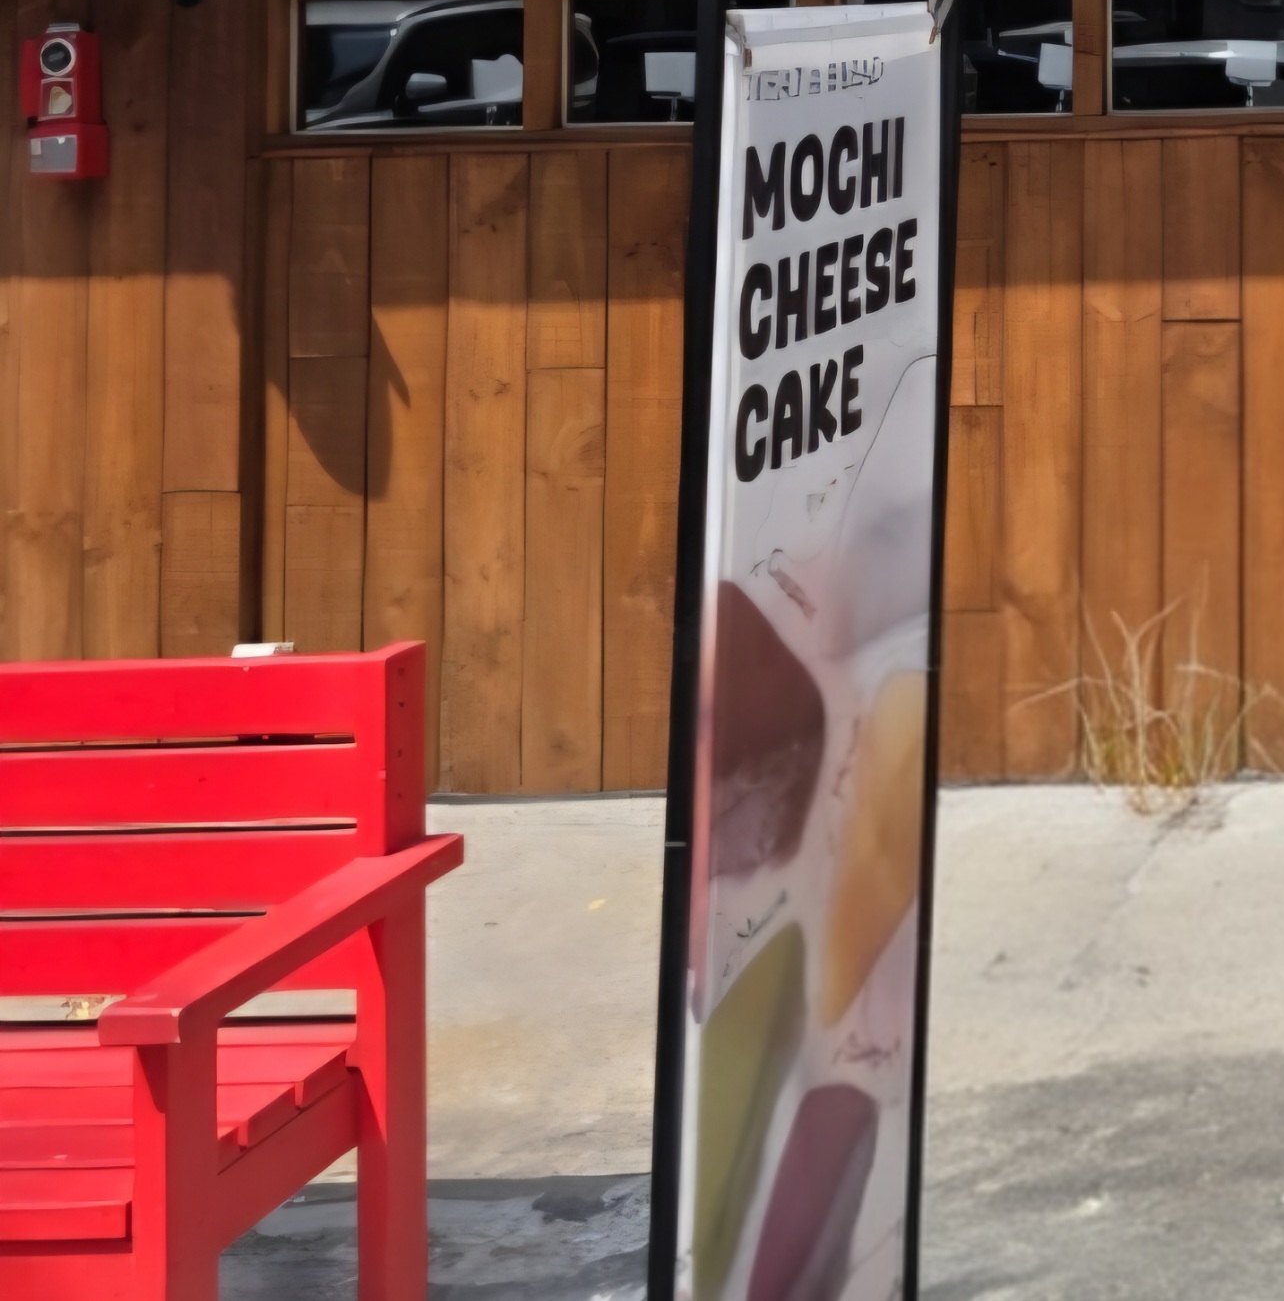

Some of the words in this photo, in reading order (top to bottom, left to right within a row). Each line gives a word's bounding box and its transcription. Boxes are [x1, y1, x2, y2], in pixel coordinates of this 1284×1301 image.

[741, 116, 905, 240] MOCHI
[738, 217, 918, 361] CHEESE
[734, 343, 865, 483] CAKE
